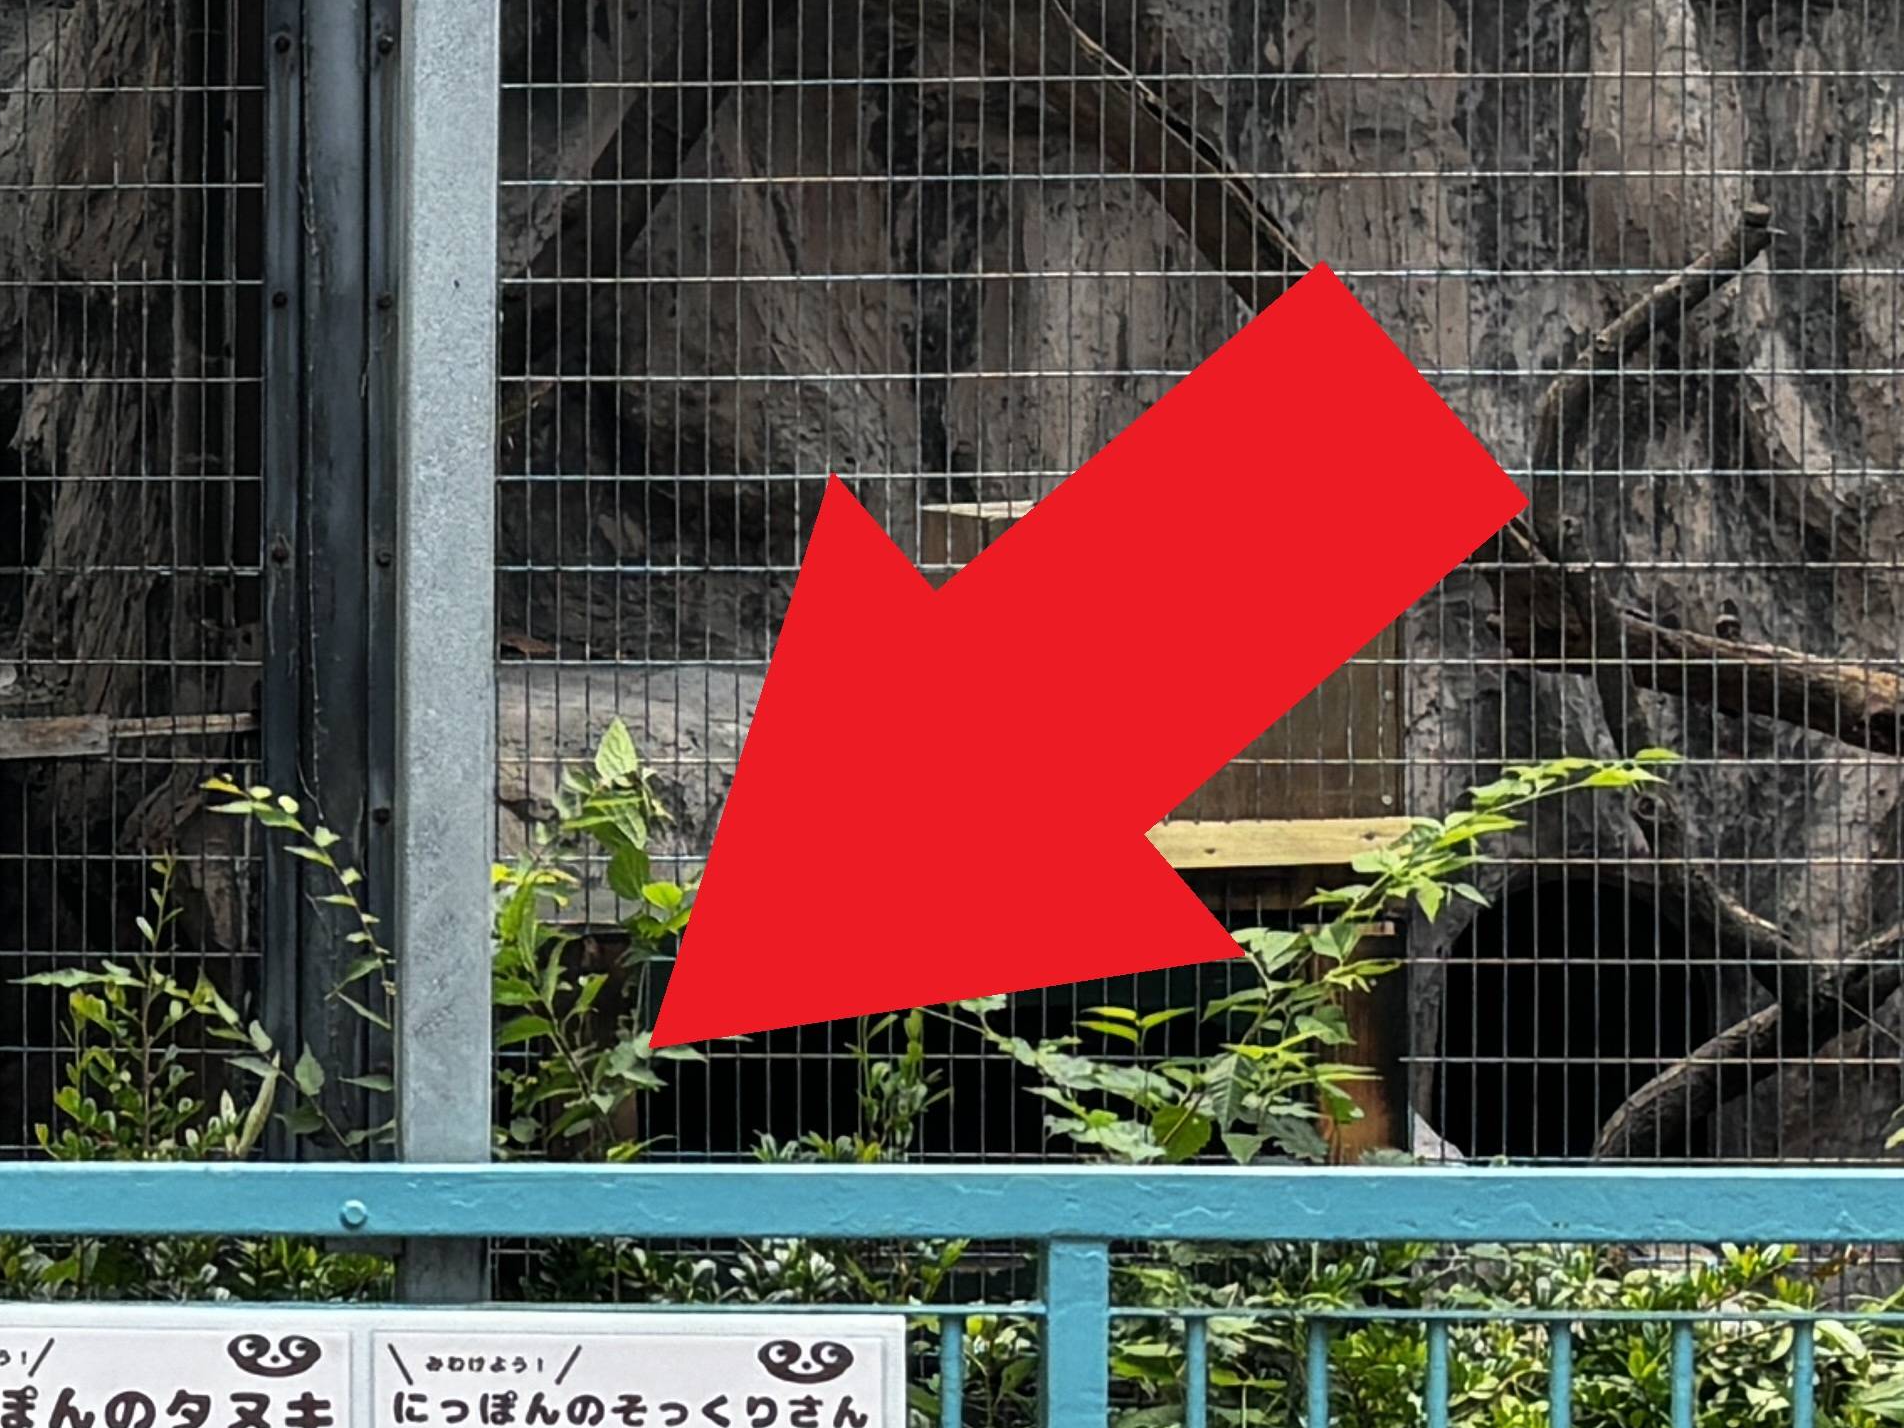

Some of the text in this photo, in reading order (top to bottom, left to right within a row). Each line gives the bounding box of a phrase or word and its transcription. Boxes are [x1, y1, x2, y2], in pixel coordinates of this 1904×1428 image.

[425, 1355, 545, 1373] みわけよう！
[393, 1390, 869, 1428] にっぽんのそっくりさん
